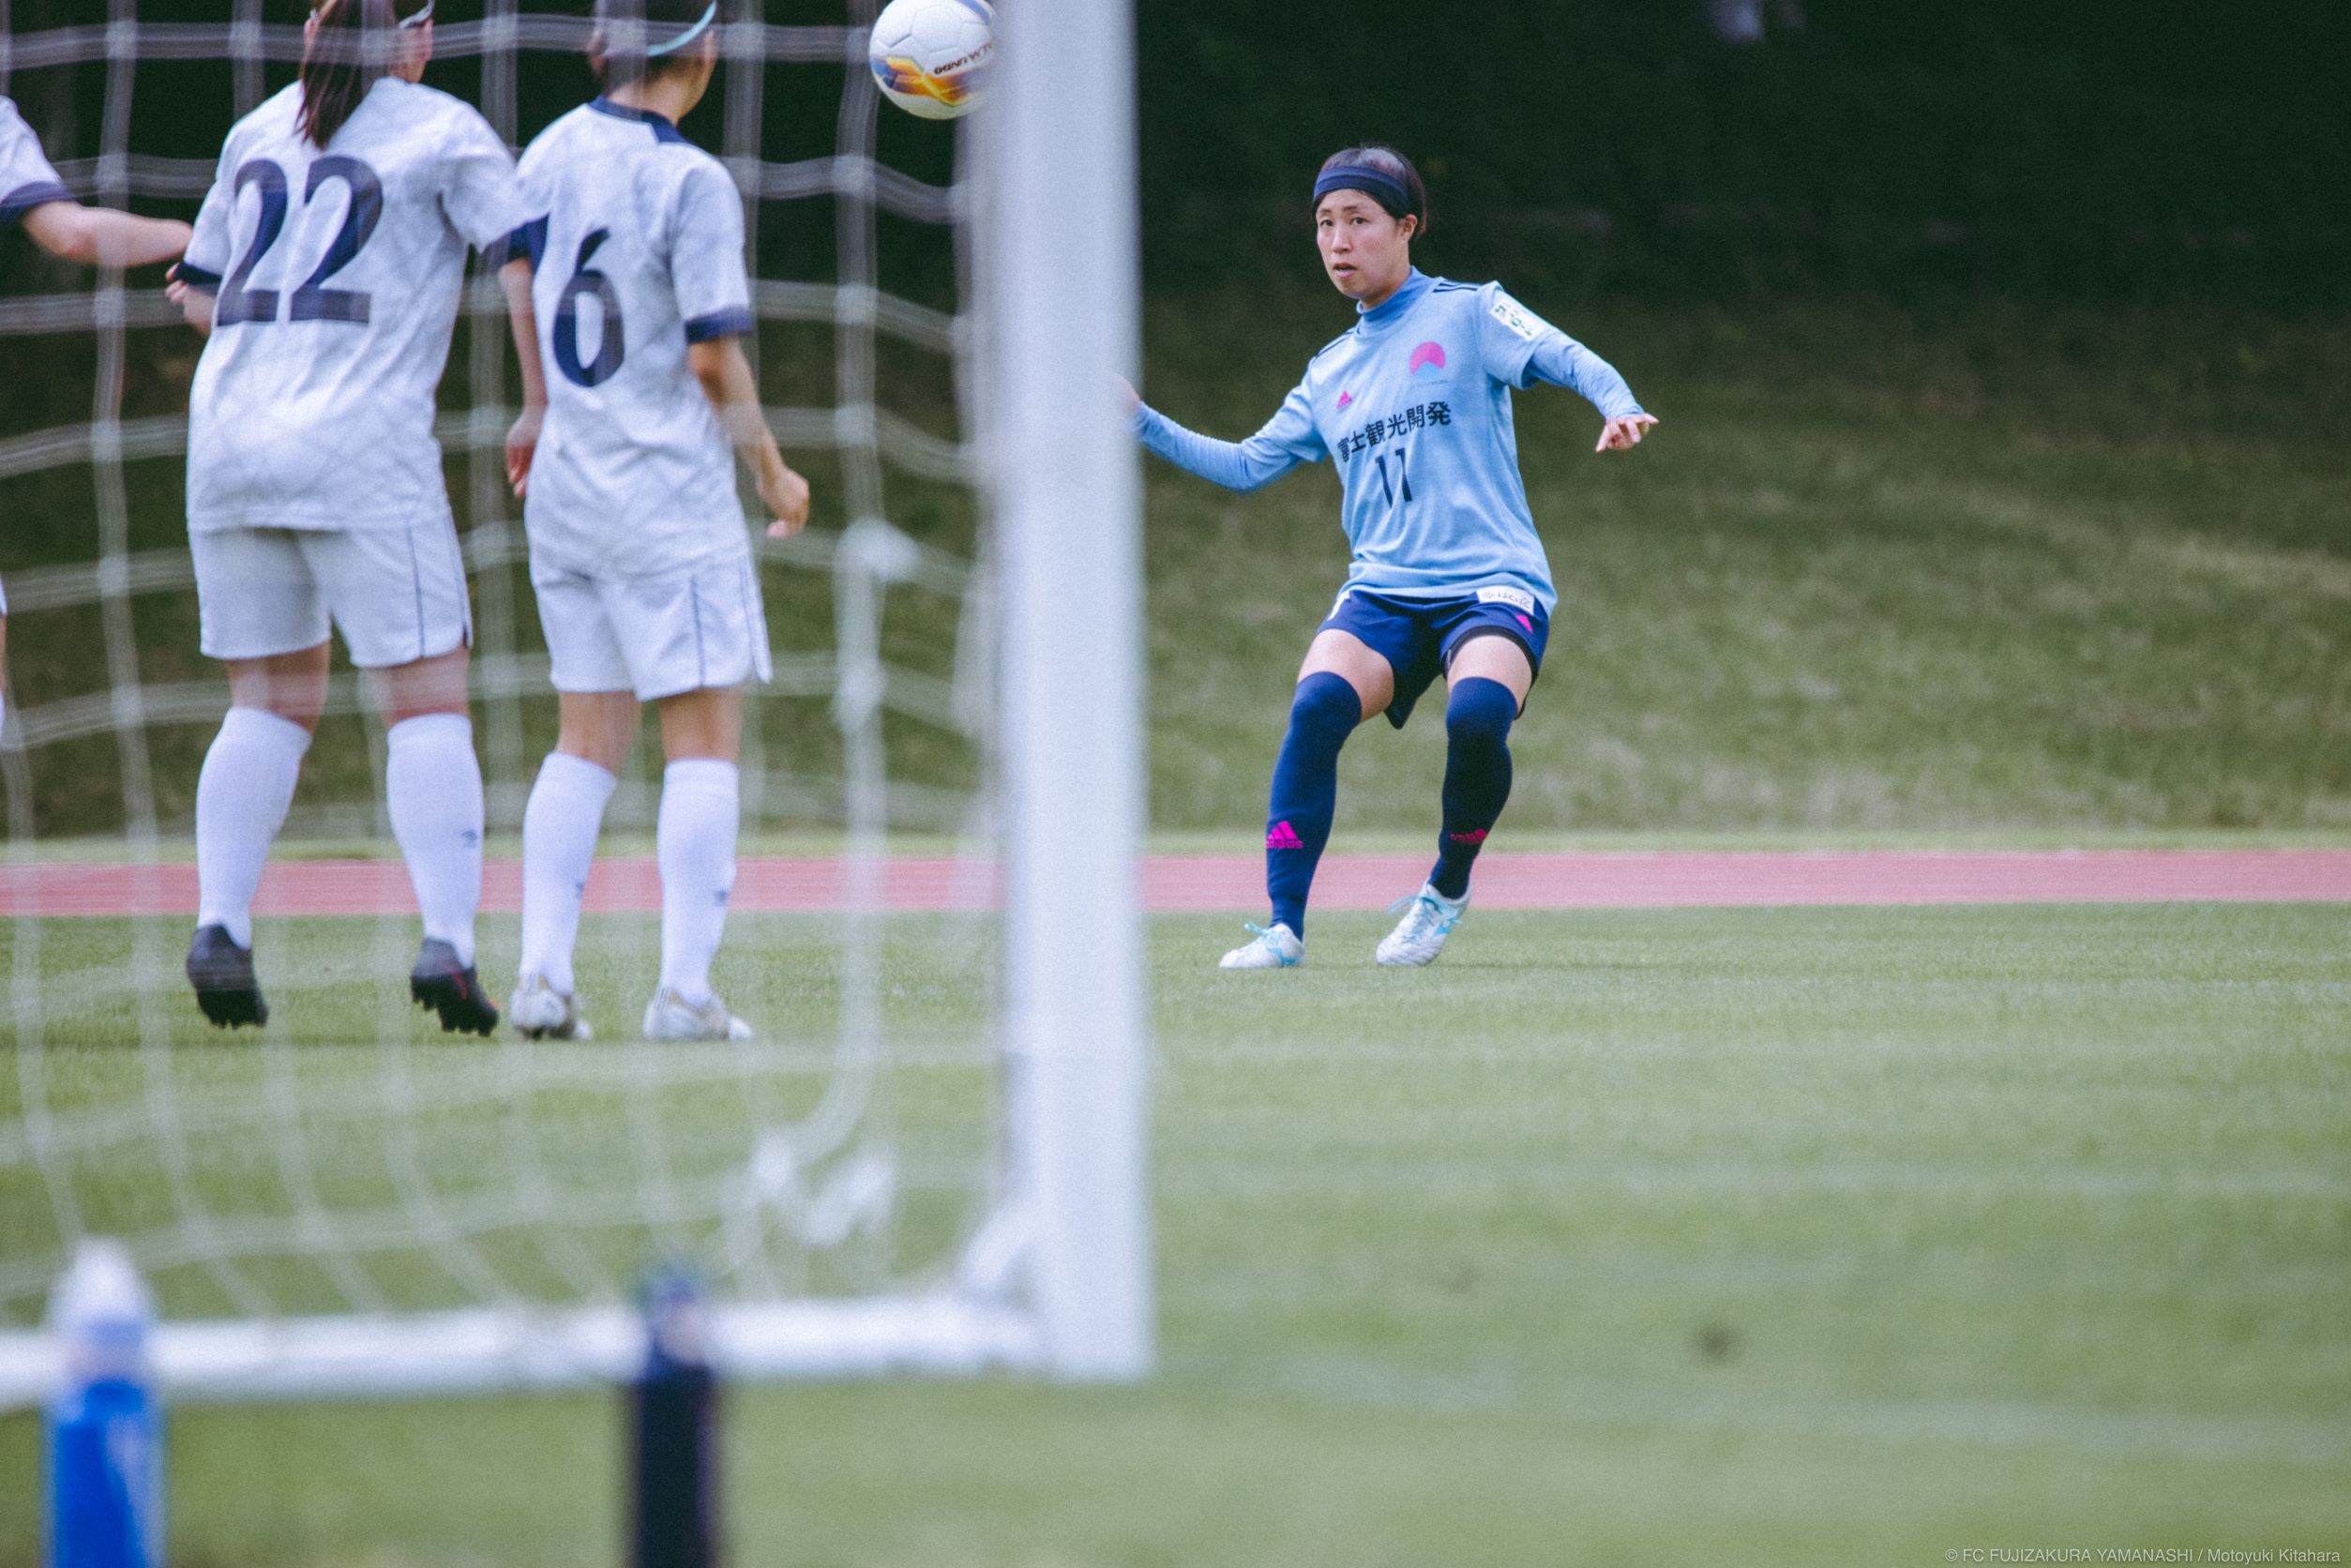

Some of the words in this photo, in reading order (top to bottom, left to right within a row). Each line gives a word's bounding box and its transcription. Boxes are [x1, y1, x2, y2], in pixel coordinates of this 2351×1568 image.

[216, 155, 384, 326] 22
[553, 227, 625, 387] 6
[1337, 400, 1452, 462] 富士観光開発
[1375, 447, 1412, 508] 11
